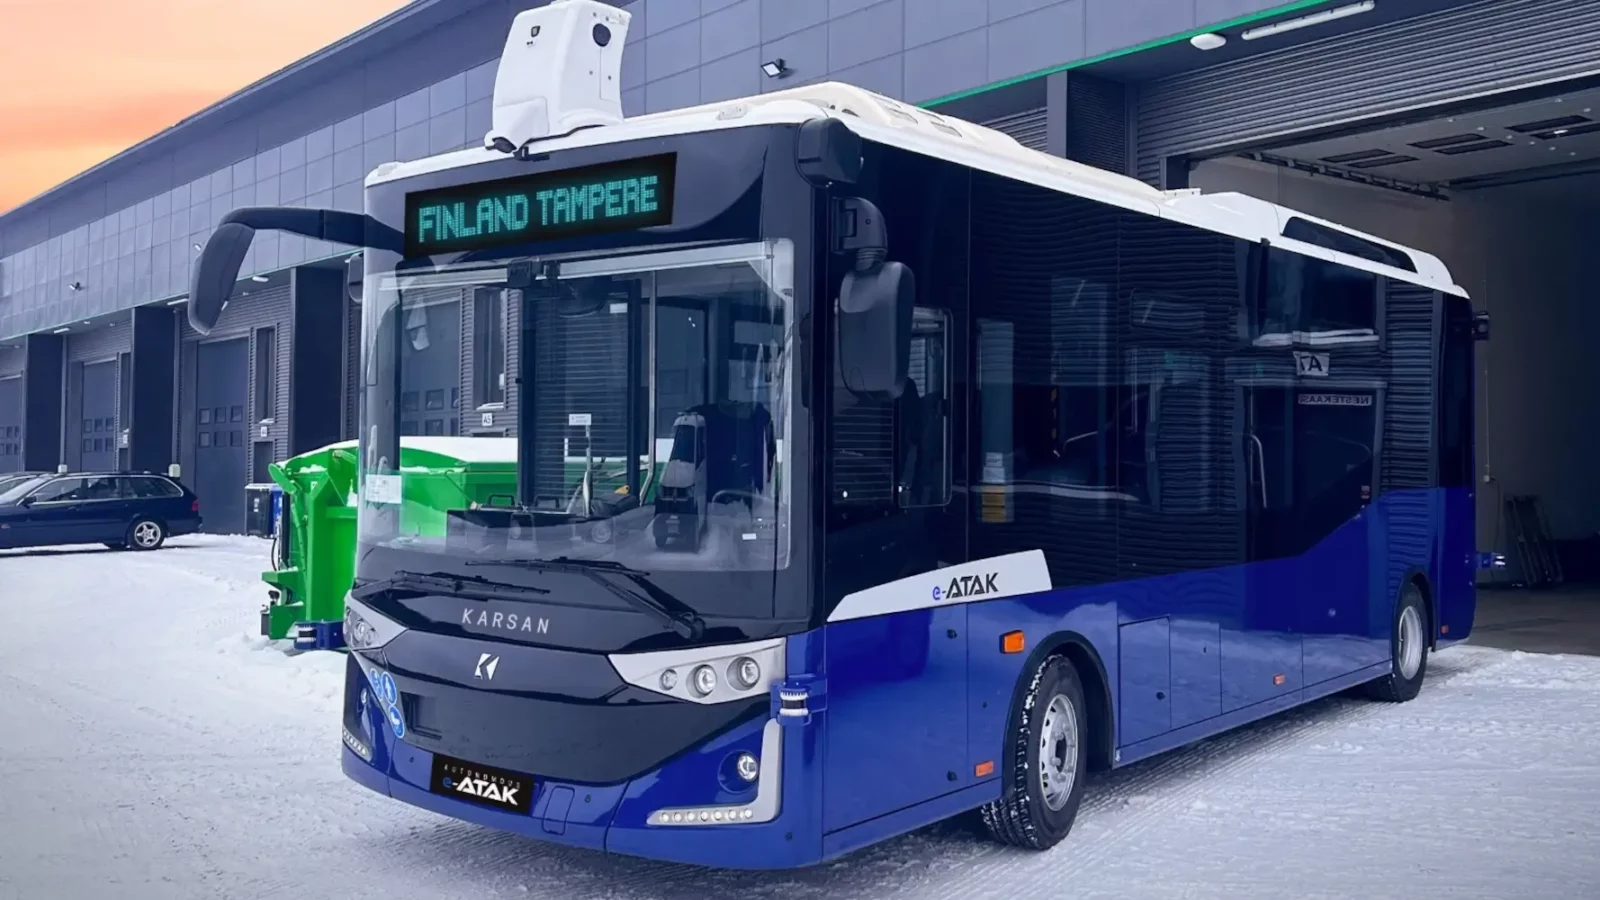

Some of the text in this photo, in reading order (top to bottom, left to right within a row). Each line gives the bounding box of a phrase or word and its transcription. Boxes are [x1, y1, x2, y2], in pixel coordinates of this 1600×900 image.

[418, 175, 658, 243] FINLAND TAMPERE
[932, 573, 998, 600] e-ATAK
[461, 608, 551, 635] KARSAN
[444, 764, 520, 789] AUTONOMOUS
[443, 776, 519, 806] e-ATAK
